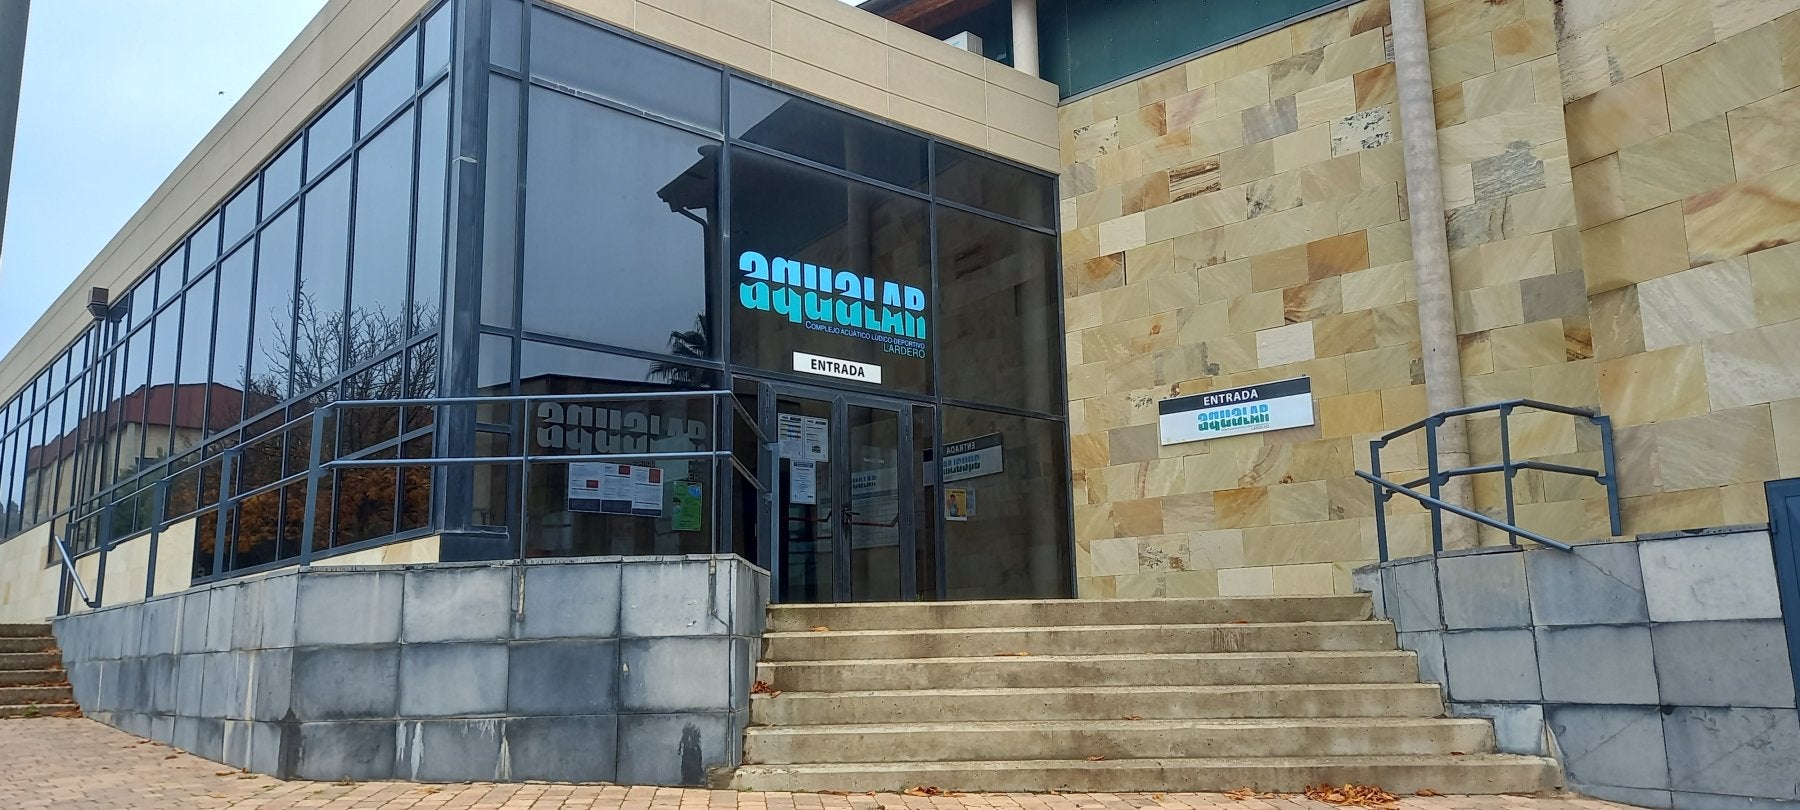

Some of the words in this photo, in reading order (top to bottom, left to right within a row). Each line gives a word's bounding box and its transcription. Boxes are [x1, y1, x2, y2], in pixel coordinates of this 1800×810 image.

[883, 342, 926, 359] LARDERO
[811, 358, 865, 378] ENTRADA
[1203, 388, 1259, 406] ENTRADA
